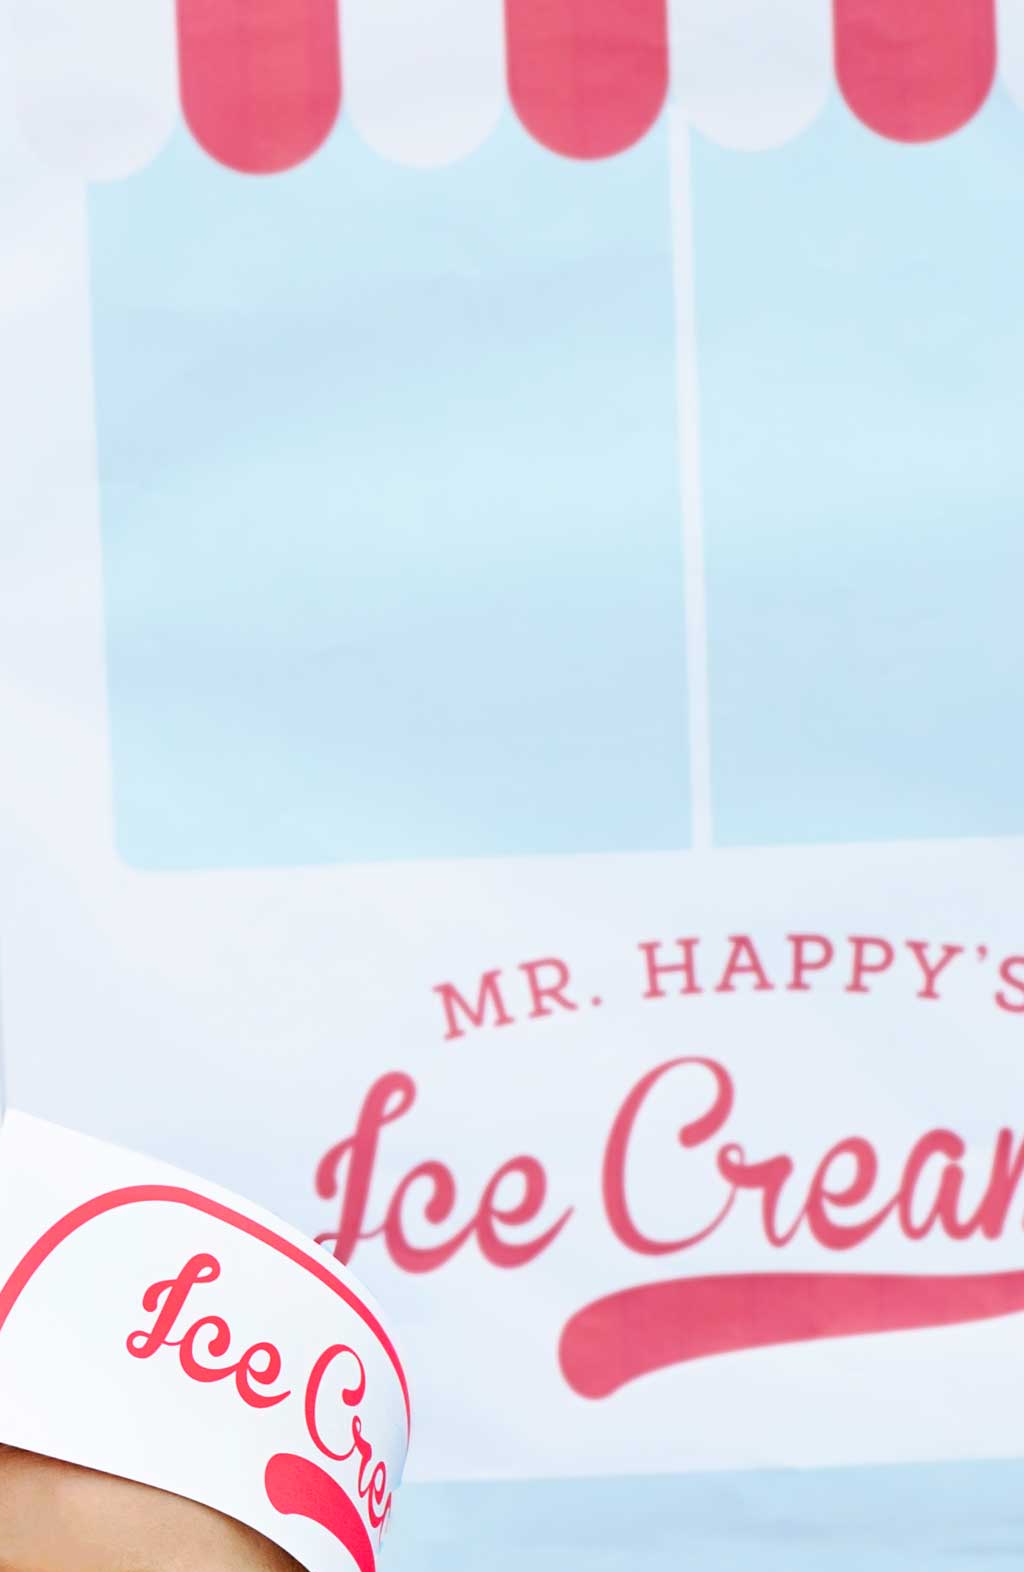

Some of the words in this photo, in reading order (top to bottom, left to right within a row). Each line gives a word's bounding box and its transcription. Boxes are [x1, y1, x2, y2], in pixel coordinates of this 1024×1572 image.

[433, 956, 603, 1042] MR.
[637, 933, 1024, 1013] HAPPY'S
[312, 1070, 575, 1274] Ice
[126, 1253, 292, 1409] Ice
[304, 1344, 393, 1535] Cre
